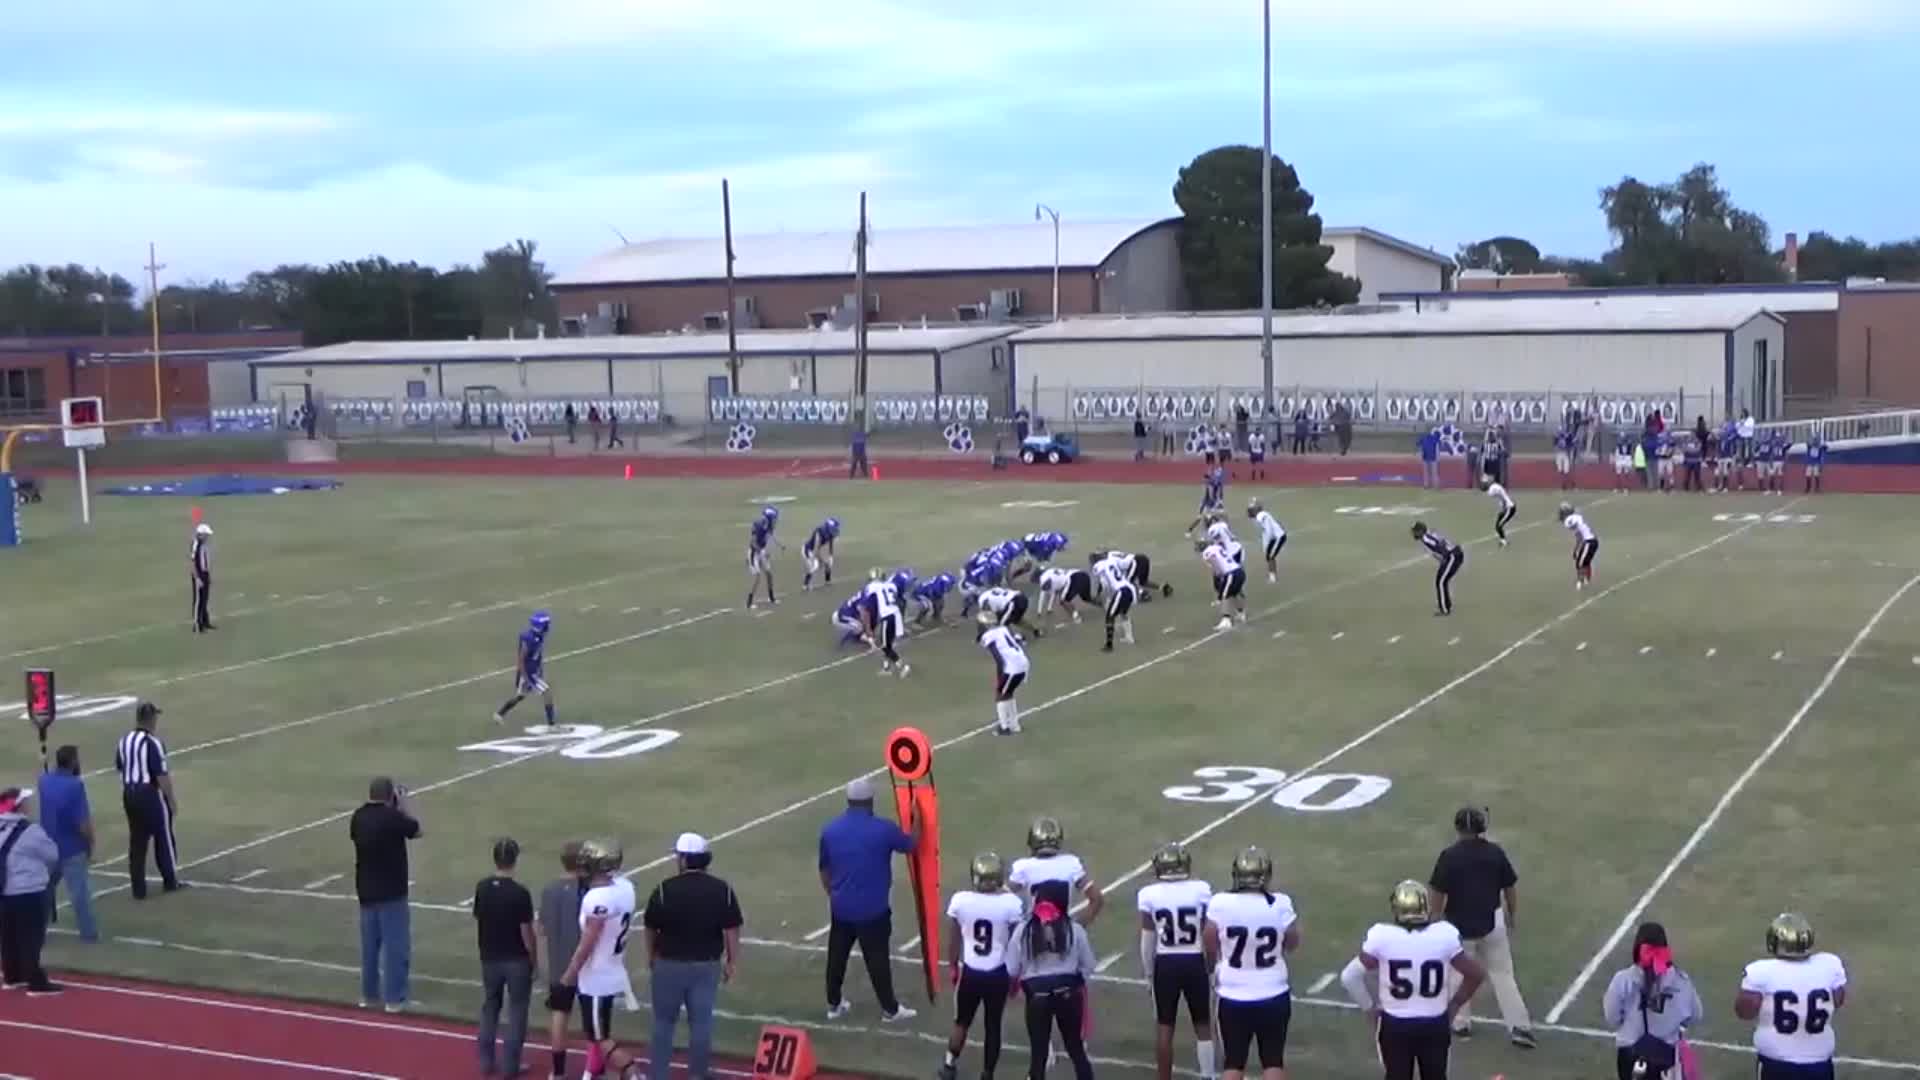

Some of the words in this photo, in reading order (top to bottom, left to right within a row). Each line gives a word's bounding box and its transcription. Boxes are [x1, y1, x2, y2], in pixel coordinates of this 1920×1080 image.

[456, 724, 682, 758] 20
[1162, 766, 1392, 810] 30
[973, 919, 993, 956] 9
[1154, 906, 1198, 947] 35
[1226, 925, 1278, 969] 72
[1388, 959, 1444, 1000] 50
[1773, 988, 1830, 1035] 66
[756, 1033, 798, 1077] 30
